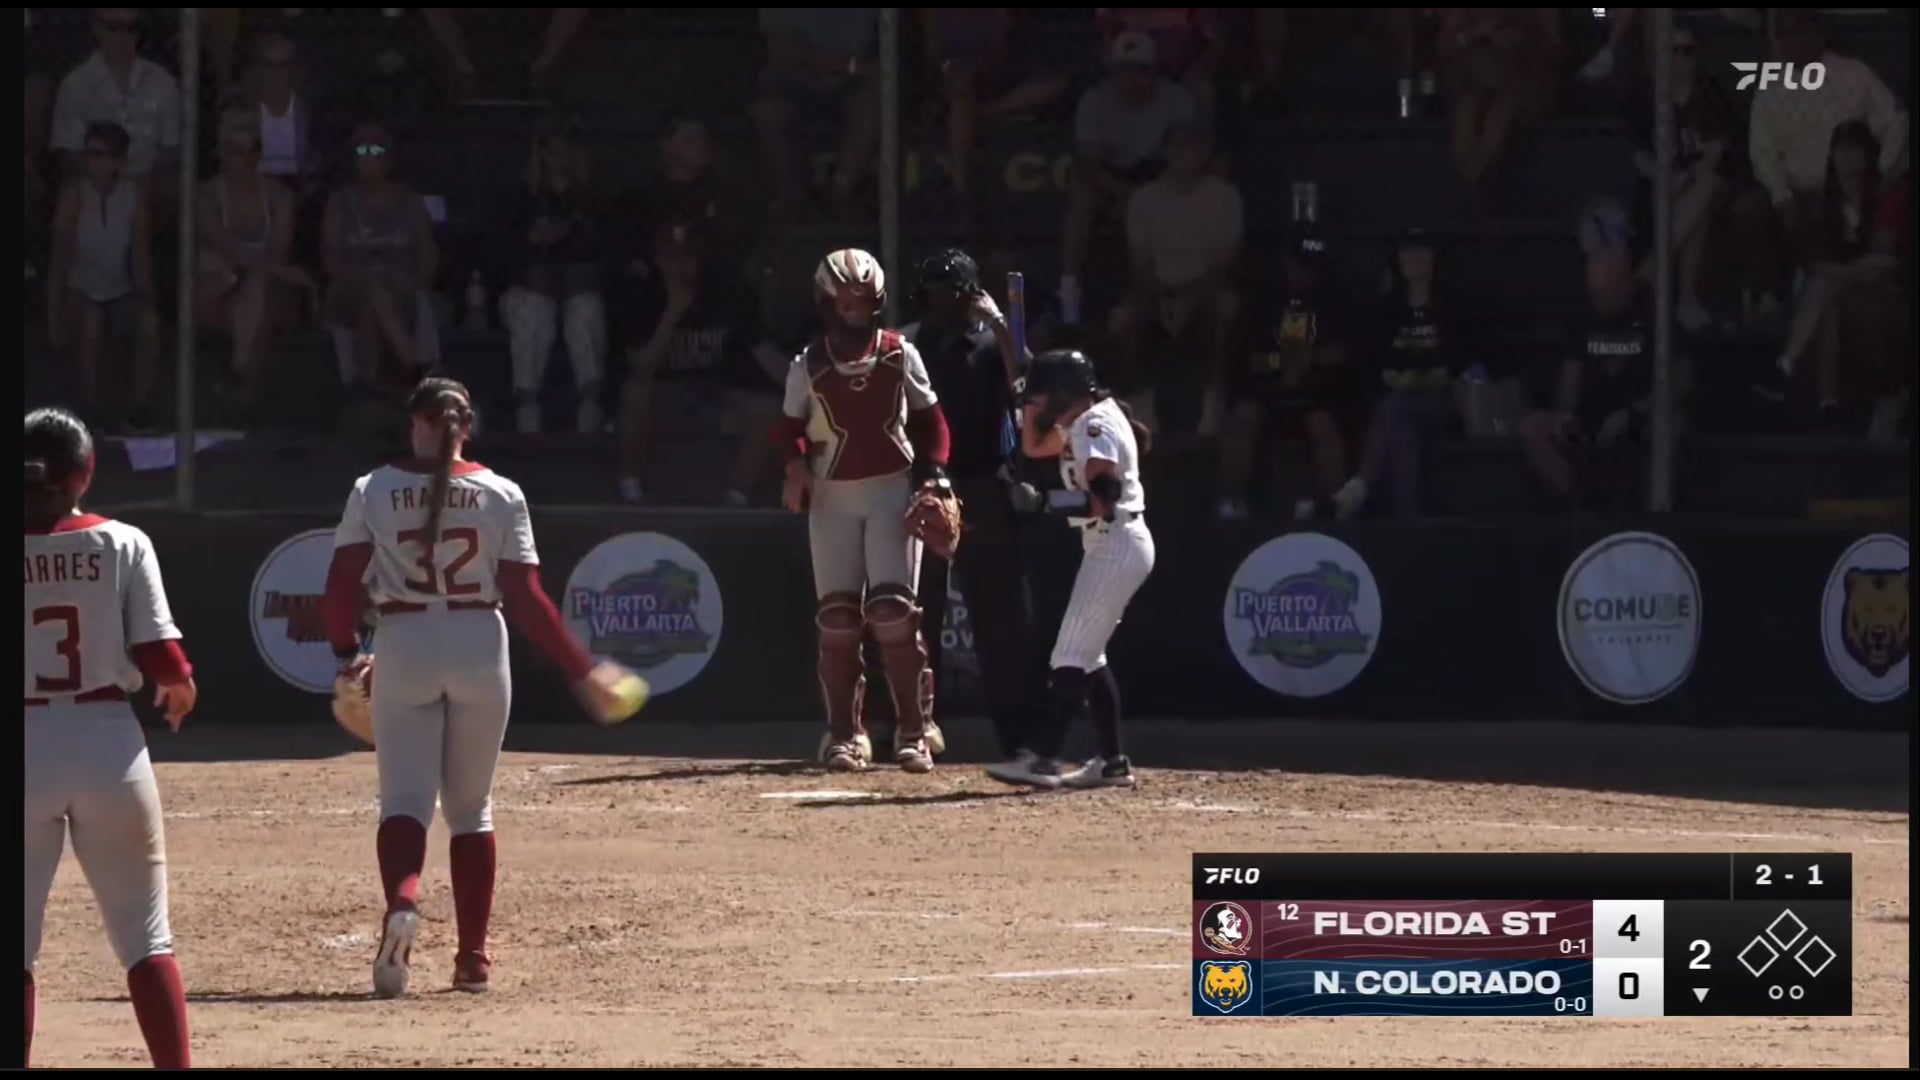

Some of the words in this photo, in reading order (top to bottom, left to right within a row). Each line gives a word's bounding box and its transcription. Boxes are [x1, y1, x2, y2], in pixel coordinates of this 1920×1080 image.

[391, 486, 482, 512] FRACIK
[397, 526, 481, 595] 32
[574, 590, 658, 616] PUERTO
[1238, 590, 1318, 616] PUERTO
[1574, 594, 1690, 621] COMUE
[591, 613, 696, 638] VALLARTA
[1253, 614, 1355, 638] VALLARTA
[32, 605, 81, 691] 3
